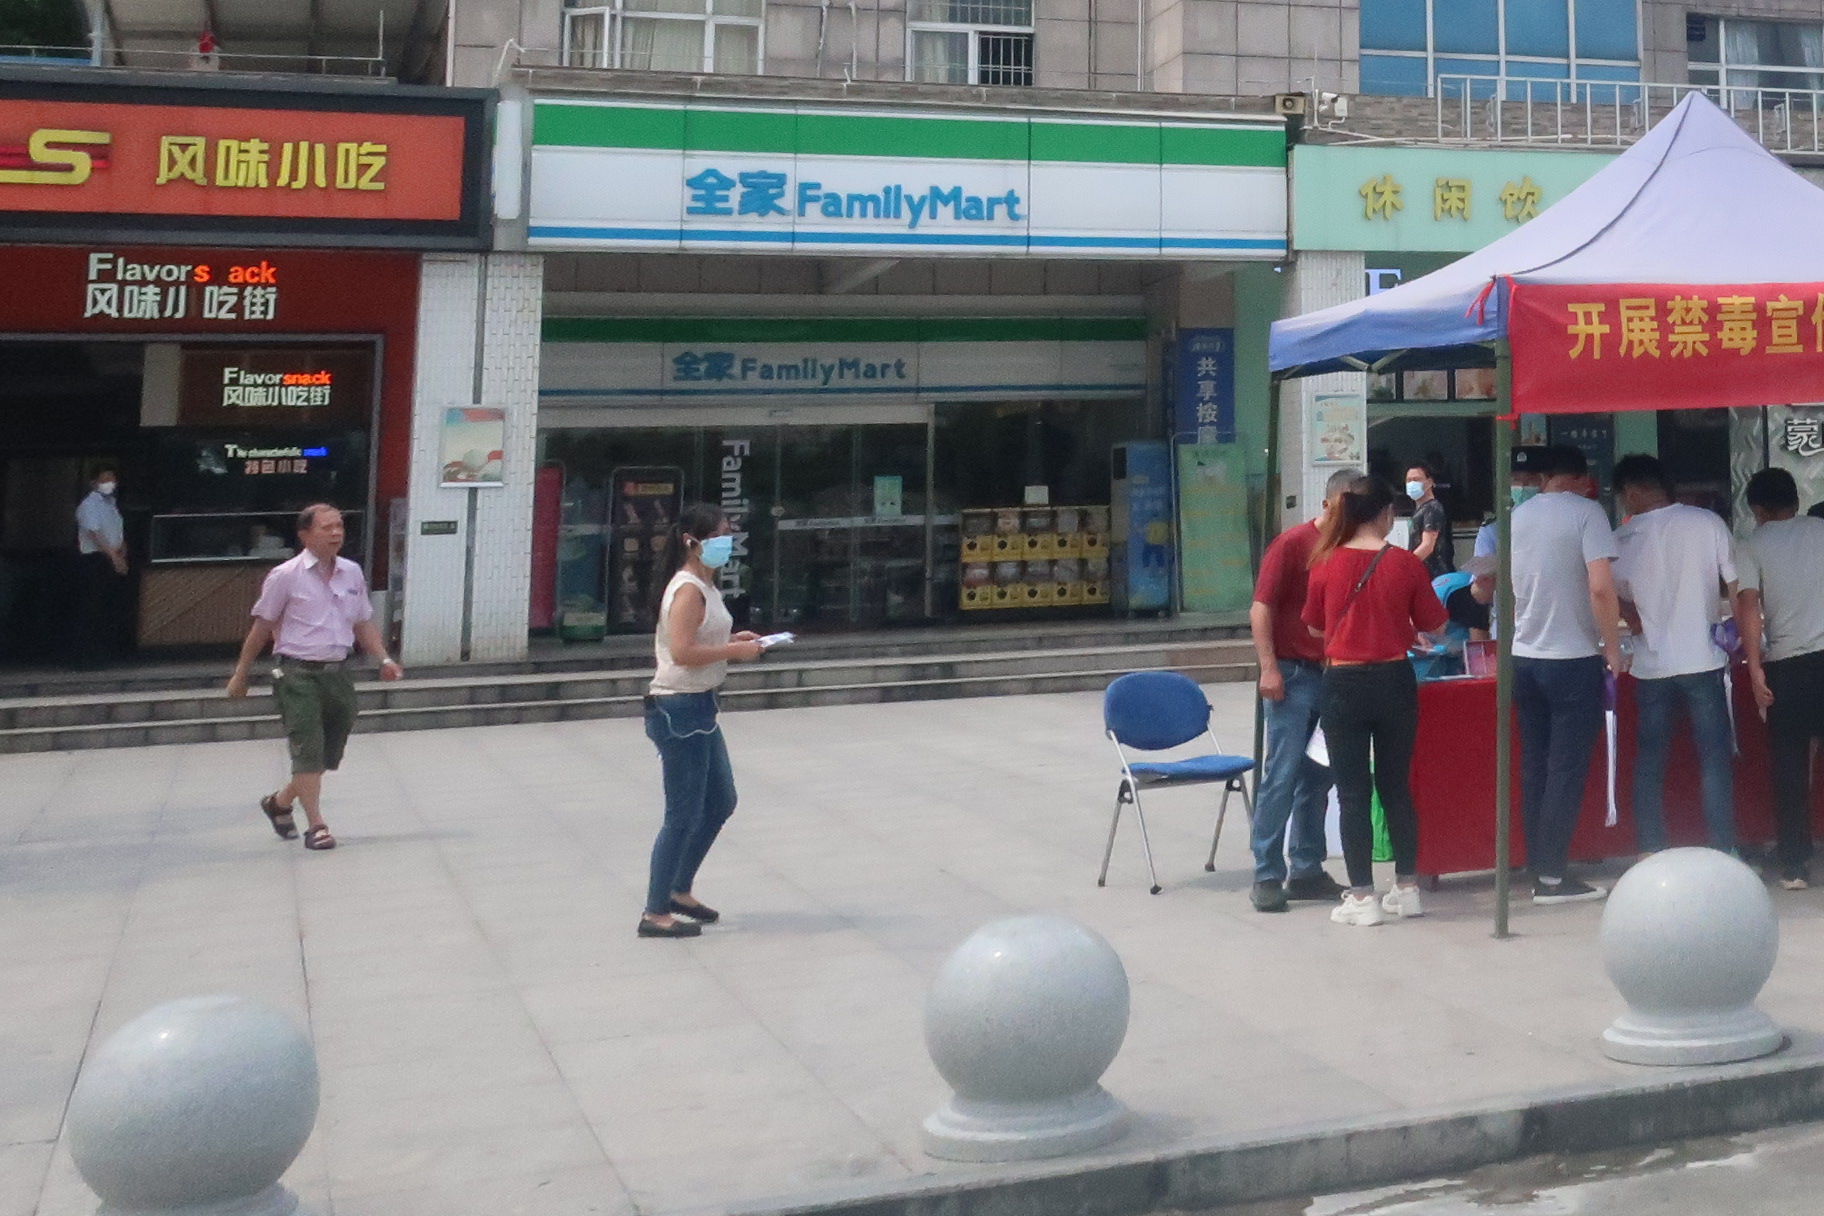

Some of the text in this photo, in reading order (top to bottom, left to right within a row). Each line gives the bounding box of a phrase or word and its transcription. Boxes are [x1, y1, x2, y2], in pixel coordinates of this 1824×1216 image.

[155, 134, 389, 191] 风味小吃
[684, 168, 1024, 230] 全家 FamilyMart
[672, 351, 907, 385] 全家 FamilyMart
[223, 386, 331, 406] 风味小吃街
